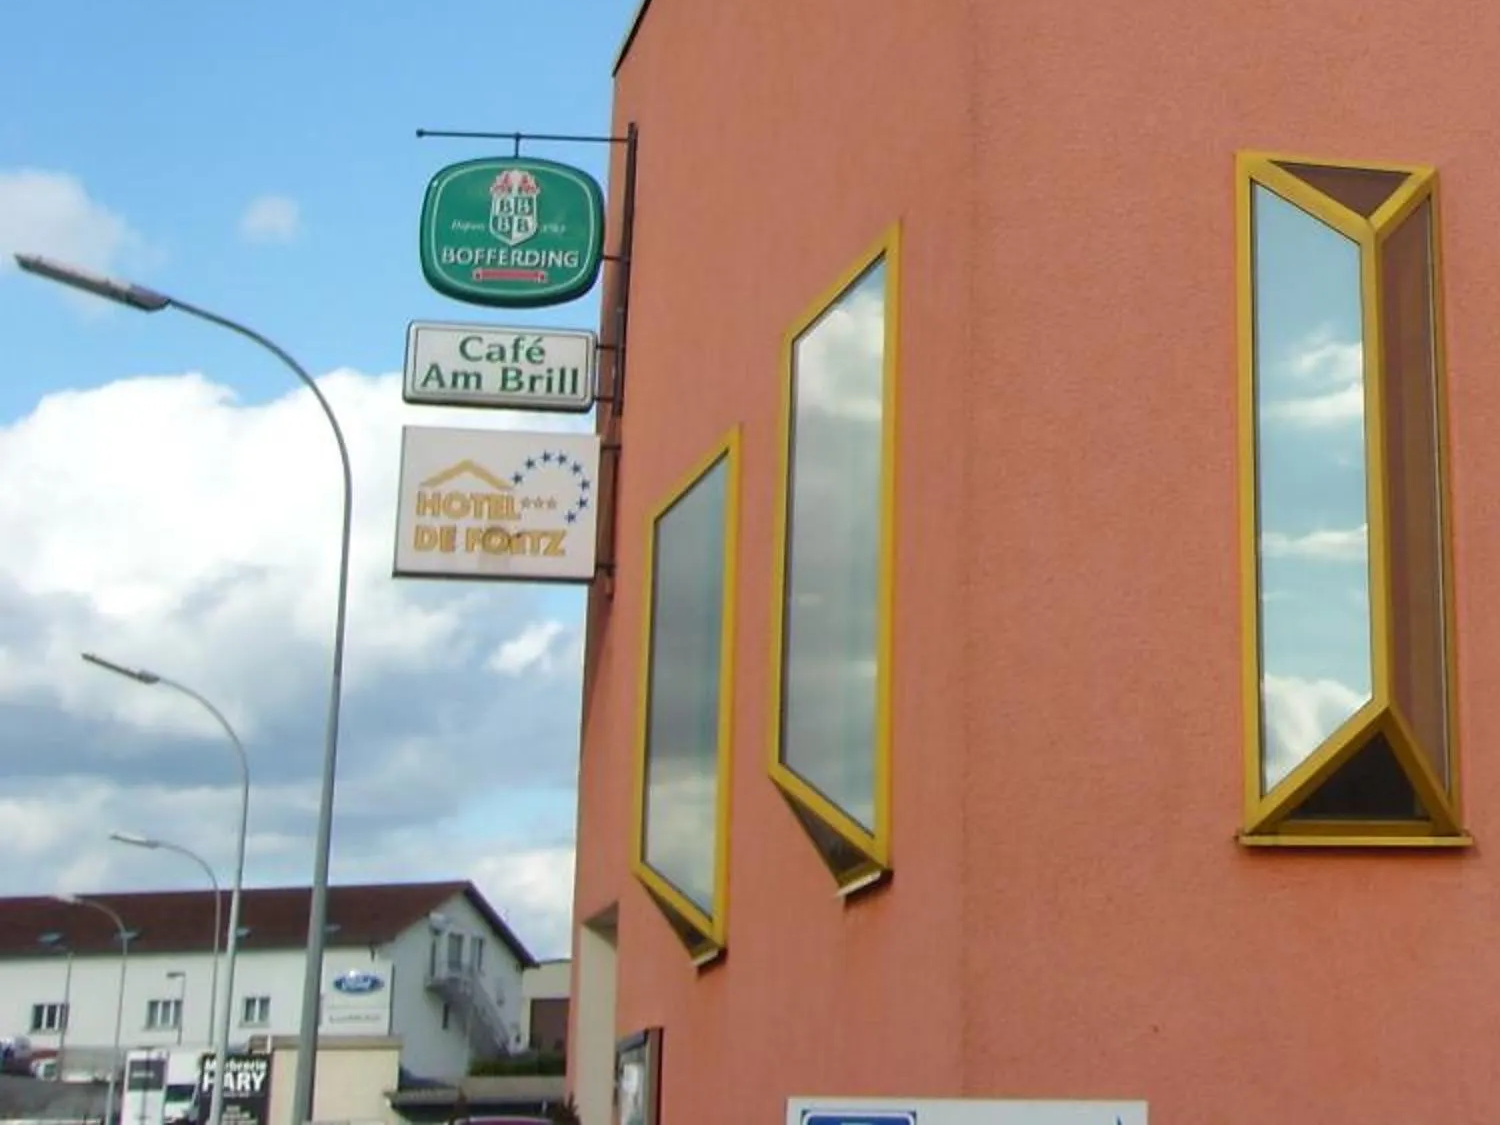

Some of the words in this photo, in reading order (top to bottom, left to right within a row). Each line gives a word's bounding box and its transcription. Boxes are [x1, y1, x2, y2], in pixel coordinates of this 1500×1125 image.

[442, 246, 579, 269] BOFFERDING
[458, 335, 545, 365] Café
[420, 363, 483, 393] Am
[500, 365, 580, 396] Brill
[416, 490, 521, 520] HOTEL
[414, 524, 457, 553] DE
